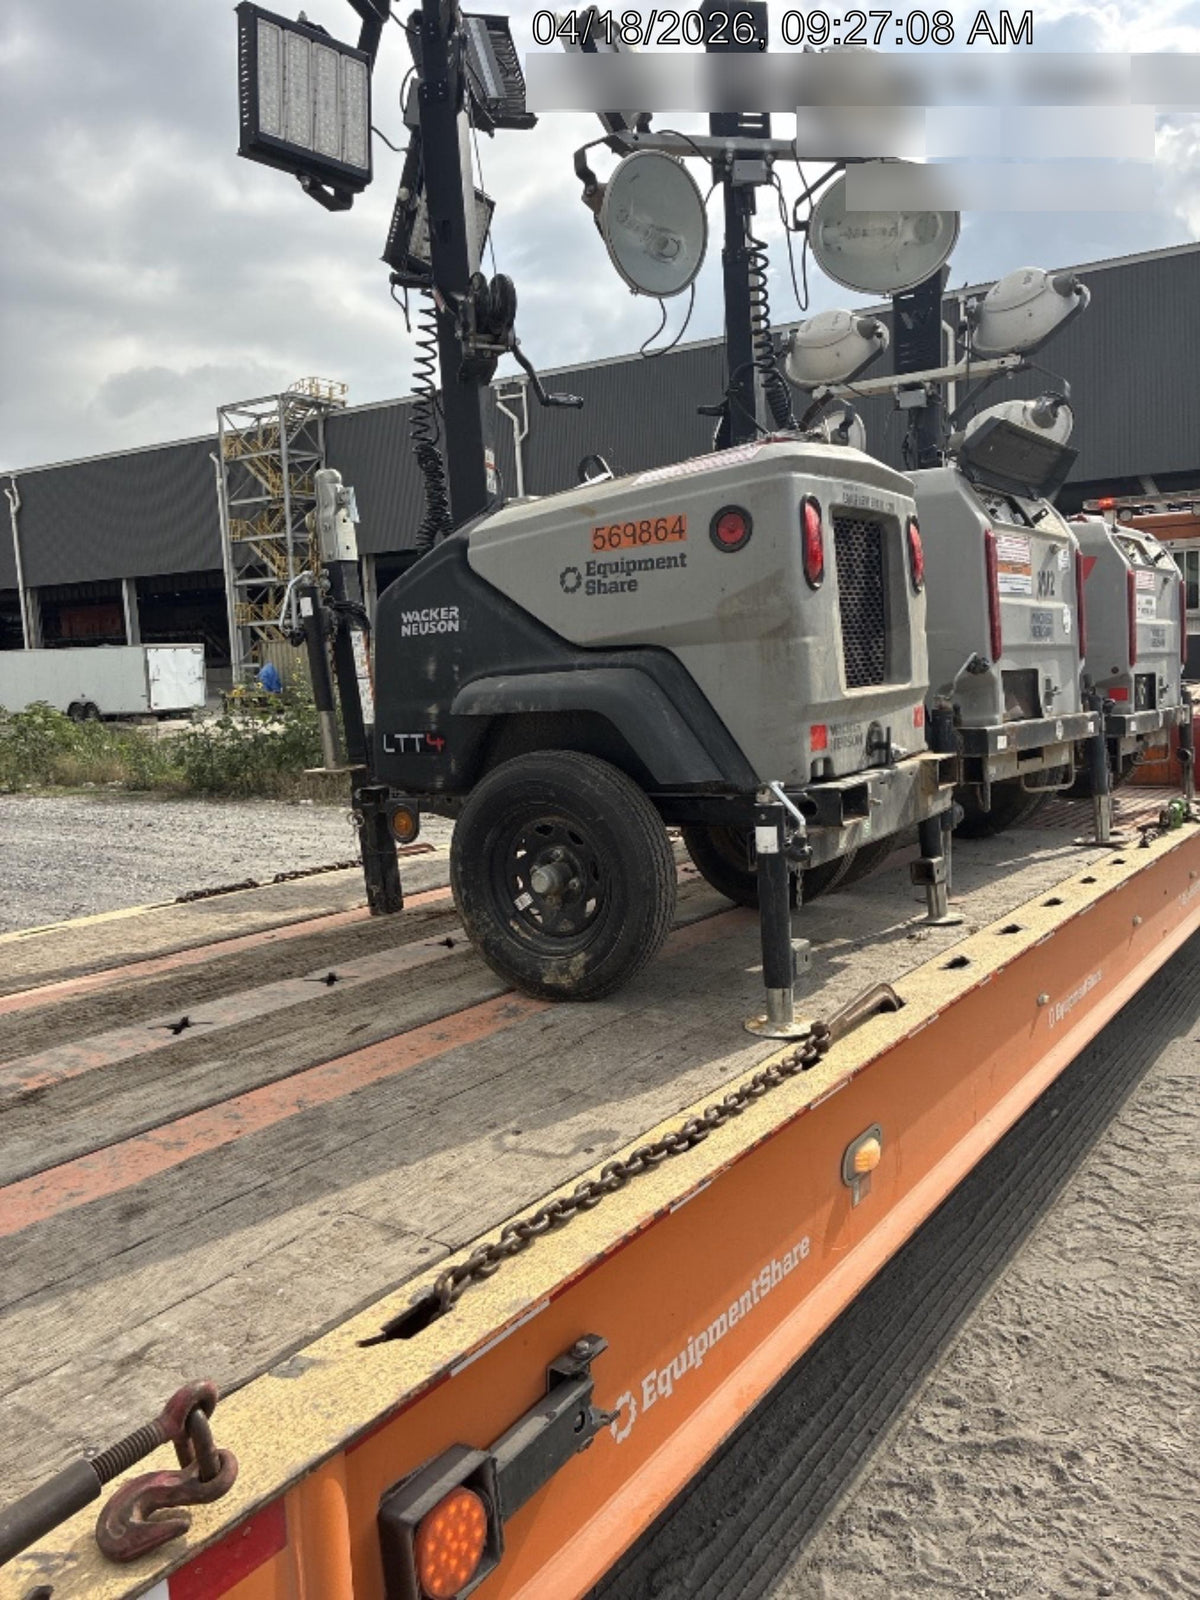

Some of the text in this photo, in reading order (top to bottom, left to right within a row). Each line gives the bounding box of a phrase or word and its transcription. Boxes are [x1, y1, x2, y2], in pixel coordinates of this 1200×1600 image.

[592, 515, 686, 550] 569864
[585, 552, 687, 577] Equipment
[585, 577, 638, 596] Share
[401, 606, 460, 622] WACKER
[401, 621, 460, 637] NEUSON
[383, 733, 445, 753] LTT4
[641, 1235, 811, 1413] EquipmentShare
